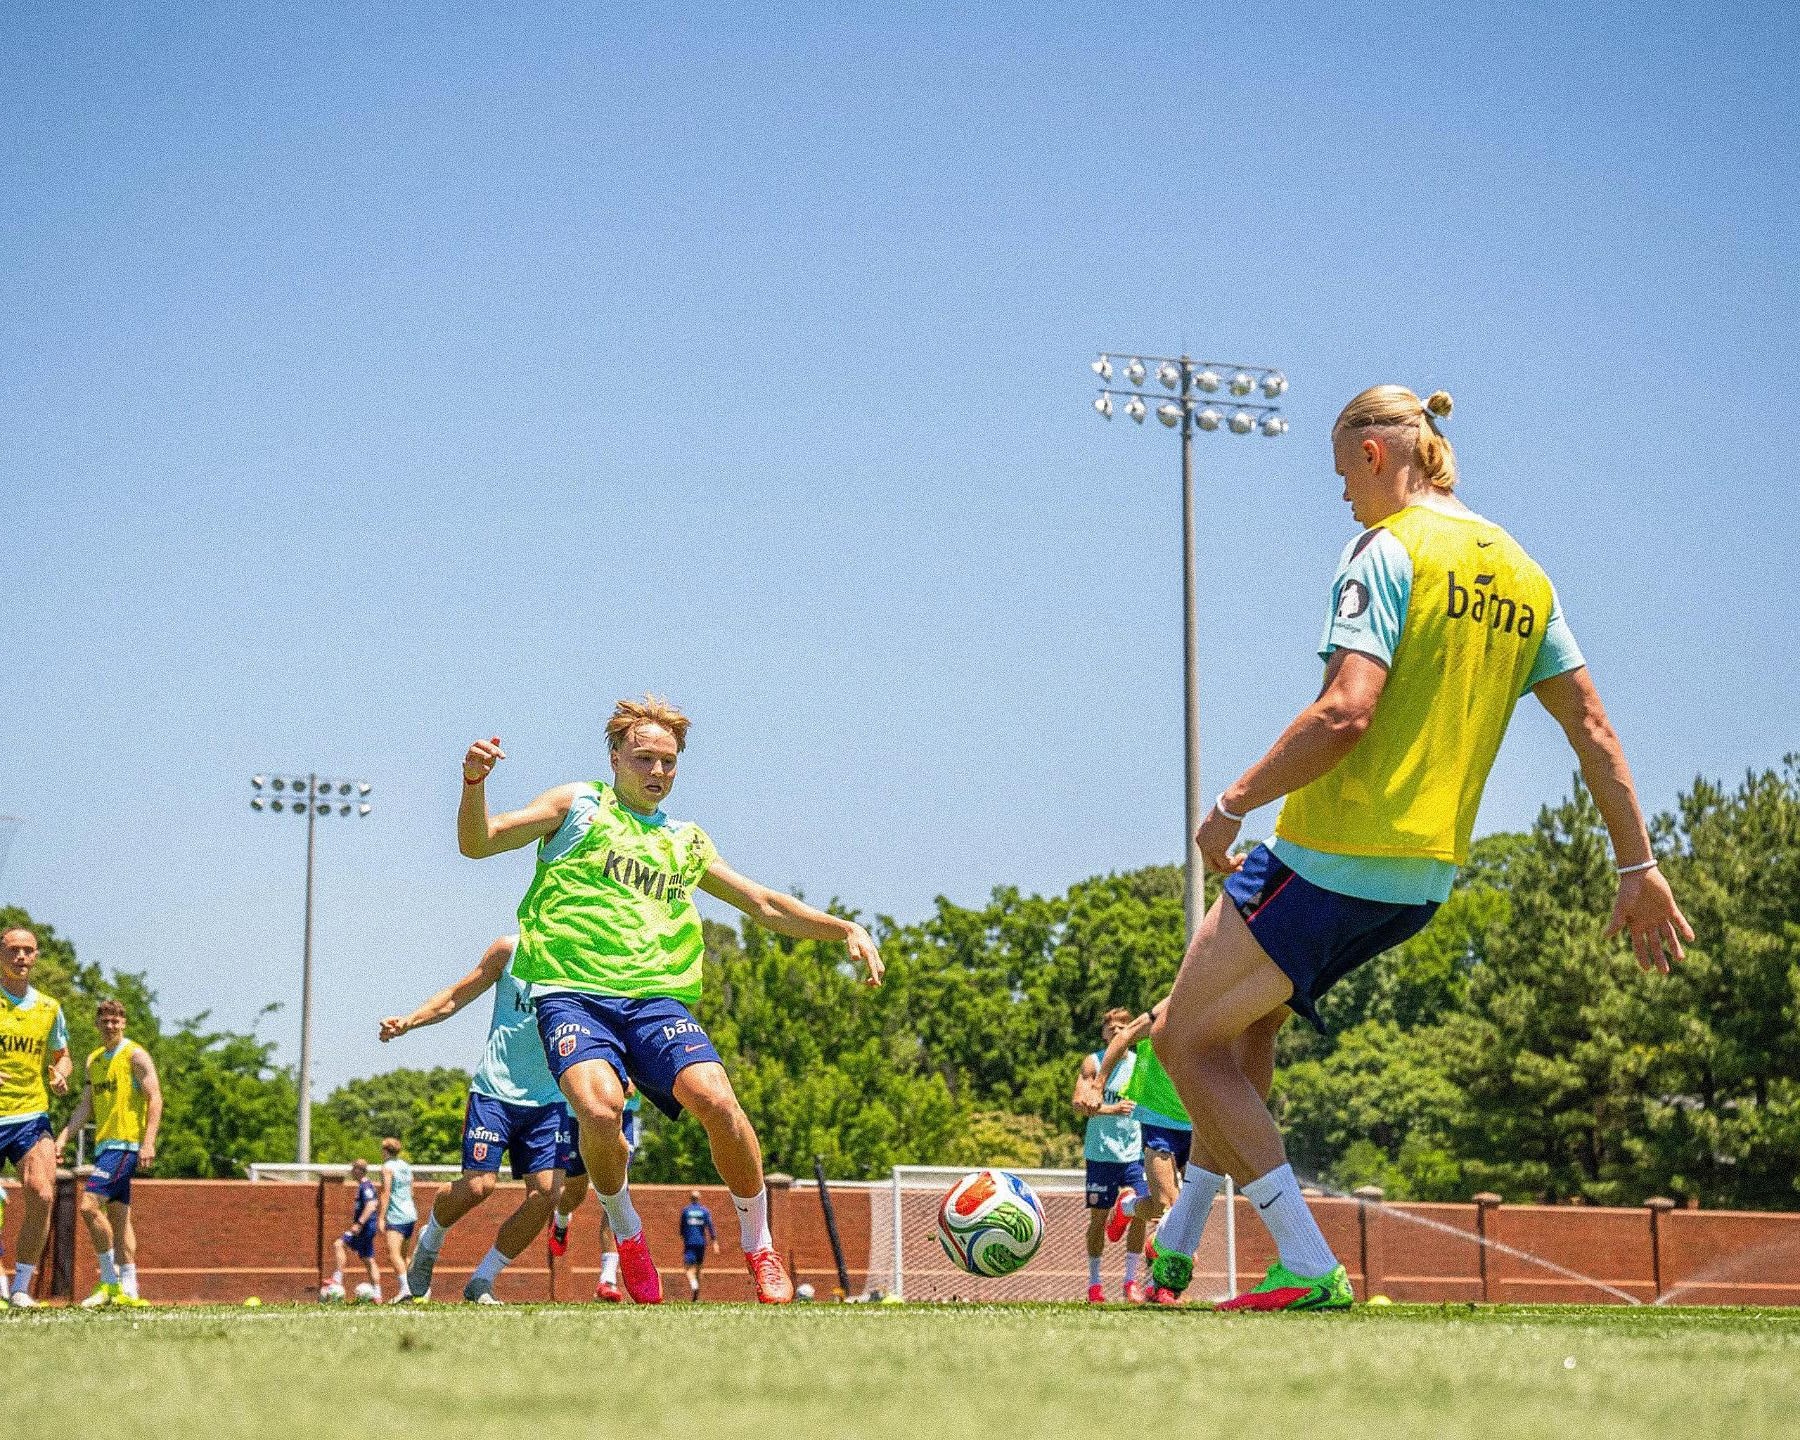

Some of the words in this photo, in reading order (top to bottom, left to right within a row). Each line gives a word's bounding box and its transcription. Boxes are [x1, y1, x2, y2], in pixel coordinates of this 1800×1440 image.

[602, 849, 667, 901] KIWI
[662, 1018, 707, 1041] bam
[555, 1130, 572, 1145] ba
